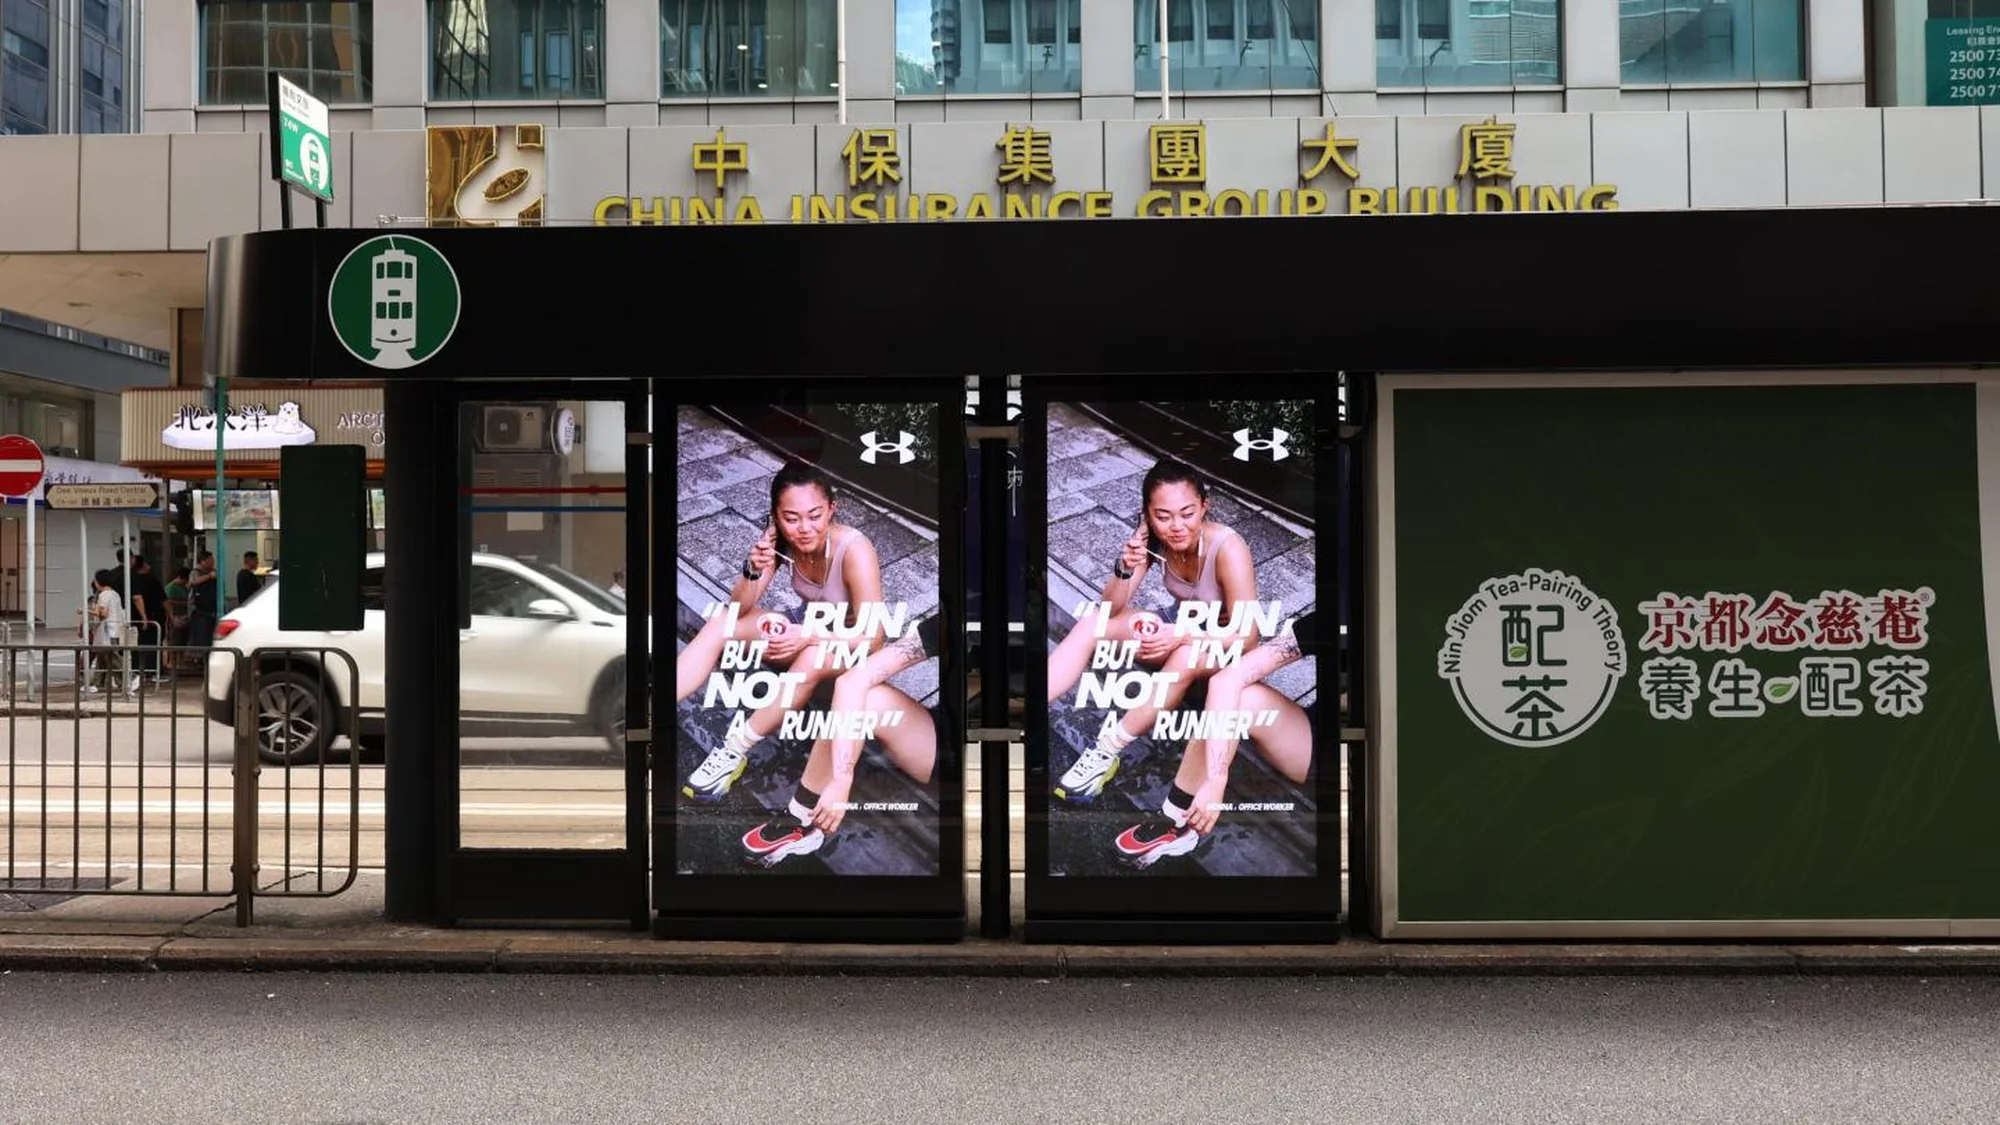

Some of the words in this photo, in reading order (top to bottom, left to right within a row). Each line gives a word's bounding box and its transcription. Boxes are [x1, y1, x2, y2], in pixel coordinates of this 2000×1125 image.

[1946, 27, 1985, 36] Leasing
[1949, 50, 1984, 63] 2500
[1949, 68, 1985, 80] 2500
[1950, 85, 1986, 98] 2500
[691, 116, 1517, 189] 中保集團大廈
[593, 196, 763, 226] CHINA
[790, 190, 1113, 224] INSURANCE
[1136, 188, 1327, 217] GROUP
[1347, 184, 1620, 215] BUILDING
[1485, 573, 1593, 612] Tea-Pairing
[800, 601, 920, 639] RUN,
[1173, 600, 1295, 638] RUN,
[1451, 598, 1488, 640] Jiom
[1592, 605, 1622, 671] Theory
[721, 640, 769, 670] BUT
[814, 639, 869, 670] I'M
[1092, 639, 1142, 670] BUT
[1186, 639, 1245, 669] I'M
[1444, 641, 1462, 673] Nin
[1499, 604, 1568, 738] 配茶
[703, 672, 806, 709] NOT
[1074, 671, 1179, 709] NOT
[726, 710, 748, 741] A
[1097, 710, 1119, 741] A
[863, 803, 887, 811] OFFICE
[888, 803, 919, 811] WORKER
[1238, 803, 1262, 811] OFFICE
[1263, 803, 1294, 811] WORKER
